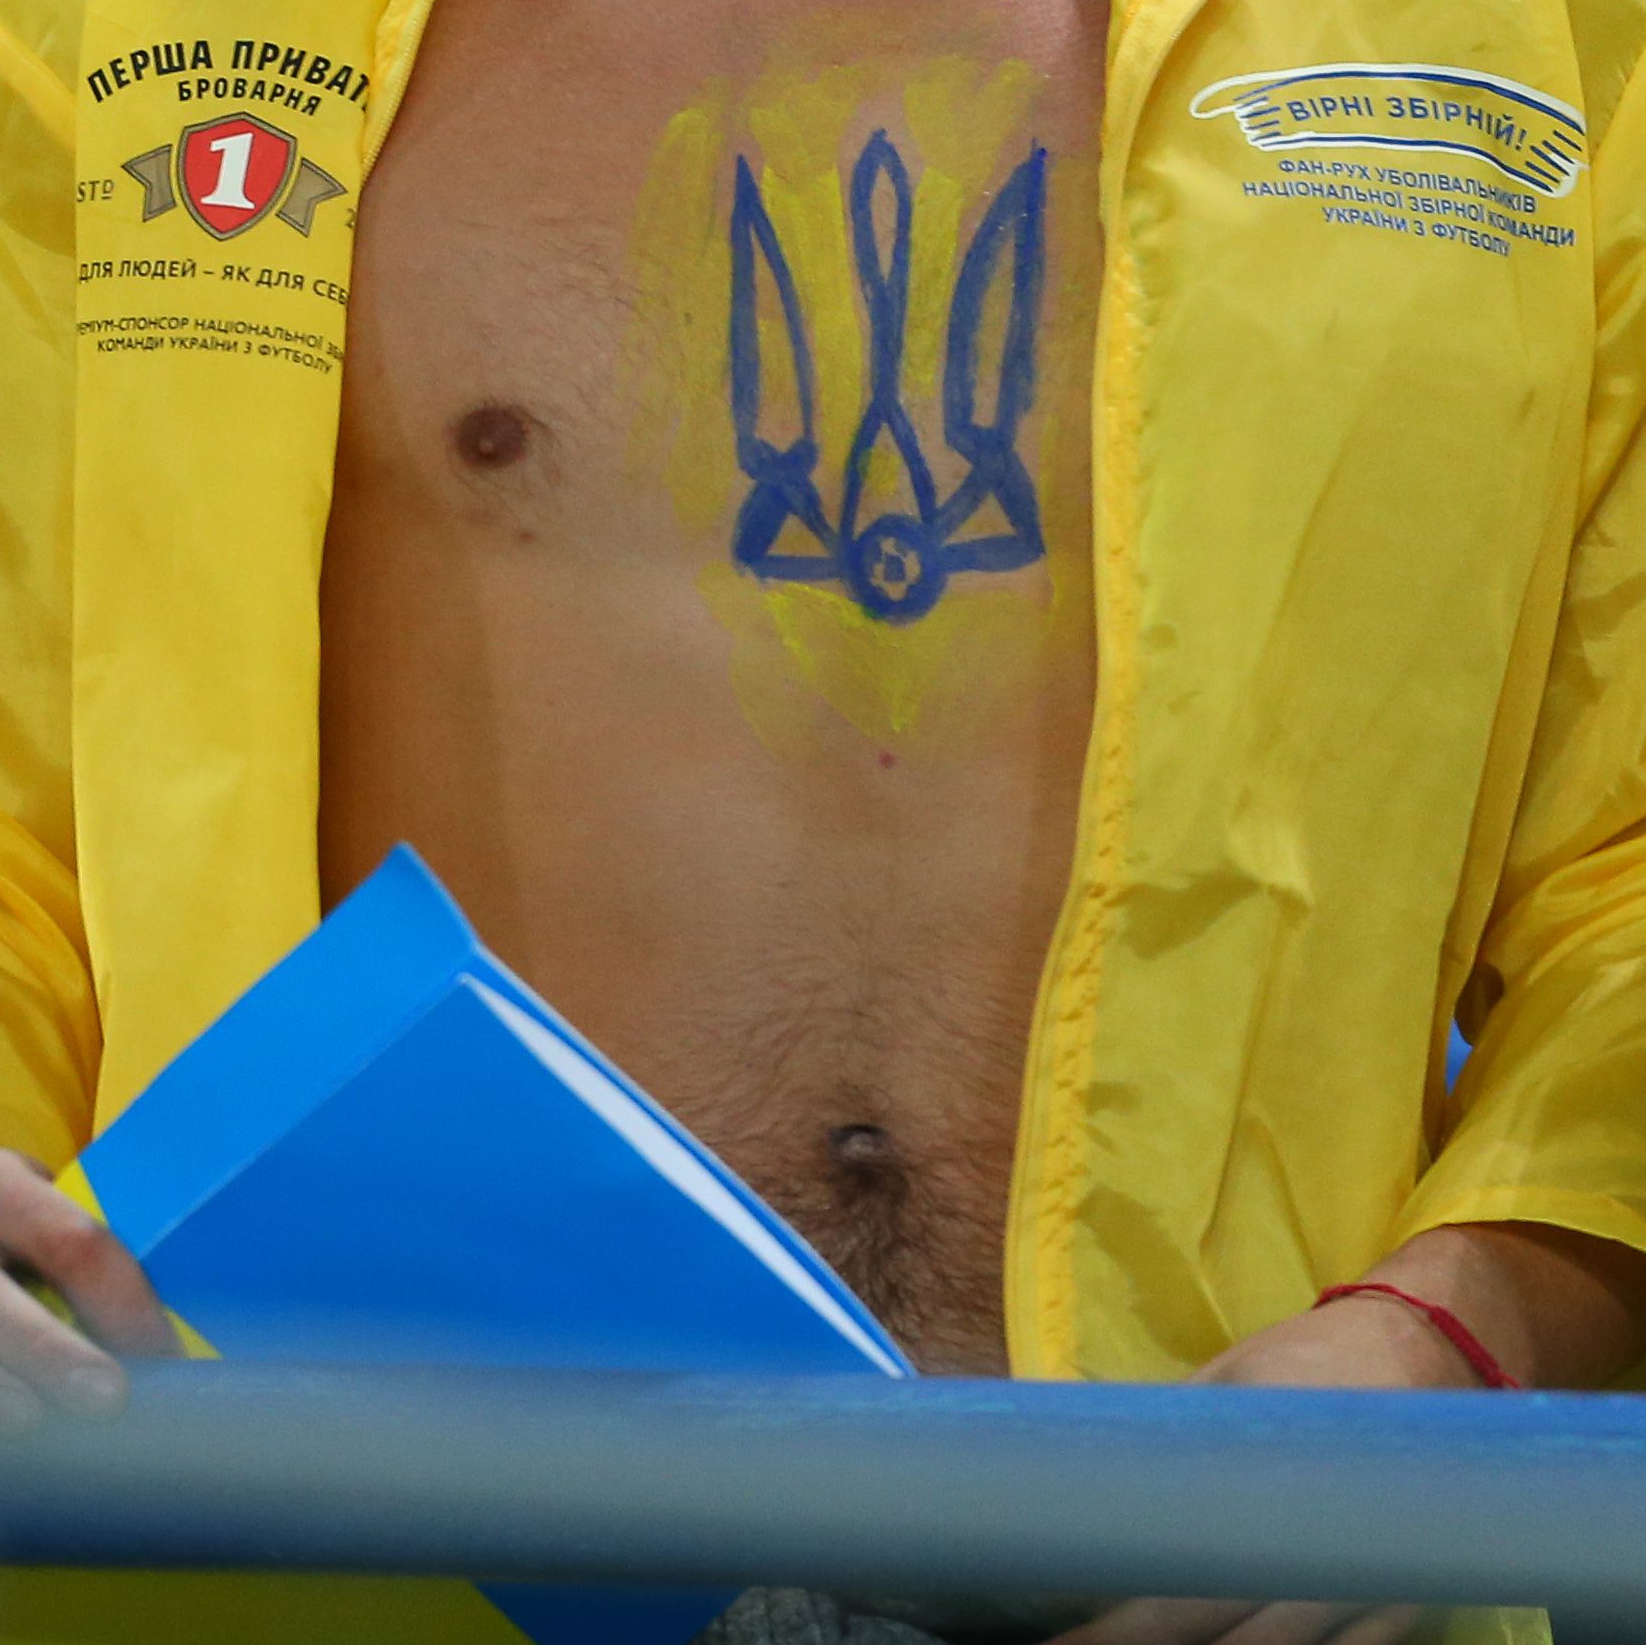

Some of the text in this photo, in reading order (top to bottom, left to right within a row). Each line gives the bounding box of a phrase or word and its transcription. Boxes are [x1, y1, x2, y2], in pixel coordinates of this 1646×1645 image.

[86, 39, 214, 104] ПЕРША
[177, 77, 322, 117] БРОВАРНЯ
[1285, 96, 1529, 152] ВІРНІ ЗБІРНІЙ!
[199, 132, 256, 211] 1
[1278, 160, 1372, 182] ФАН-РУХ
[1242, 181, 1405, 211] НАЦІОНАЛЬНОЇ
[1321, 206, 1409, 233] УКРАЇНИ
[118, 258, 197, 281] ЛЮДЕЙ
[221, 264, 252, 283] ЯК
[255, 268, 306, 291] ДЛЯ
